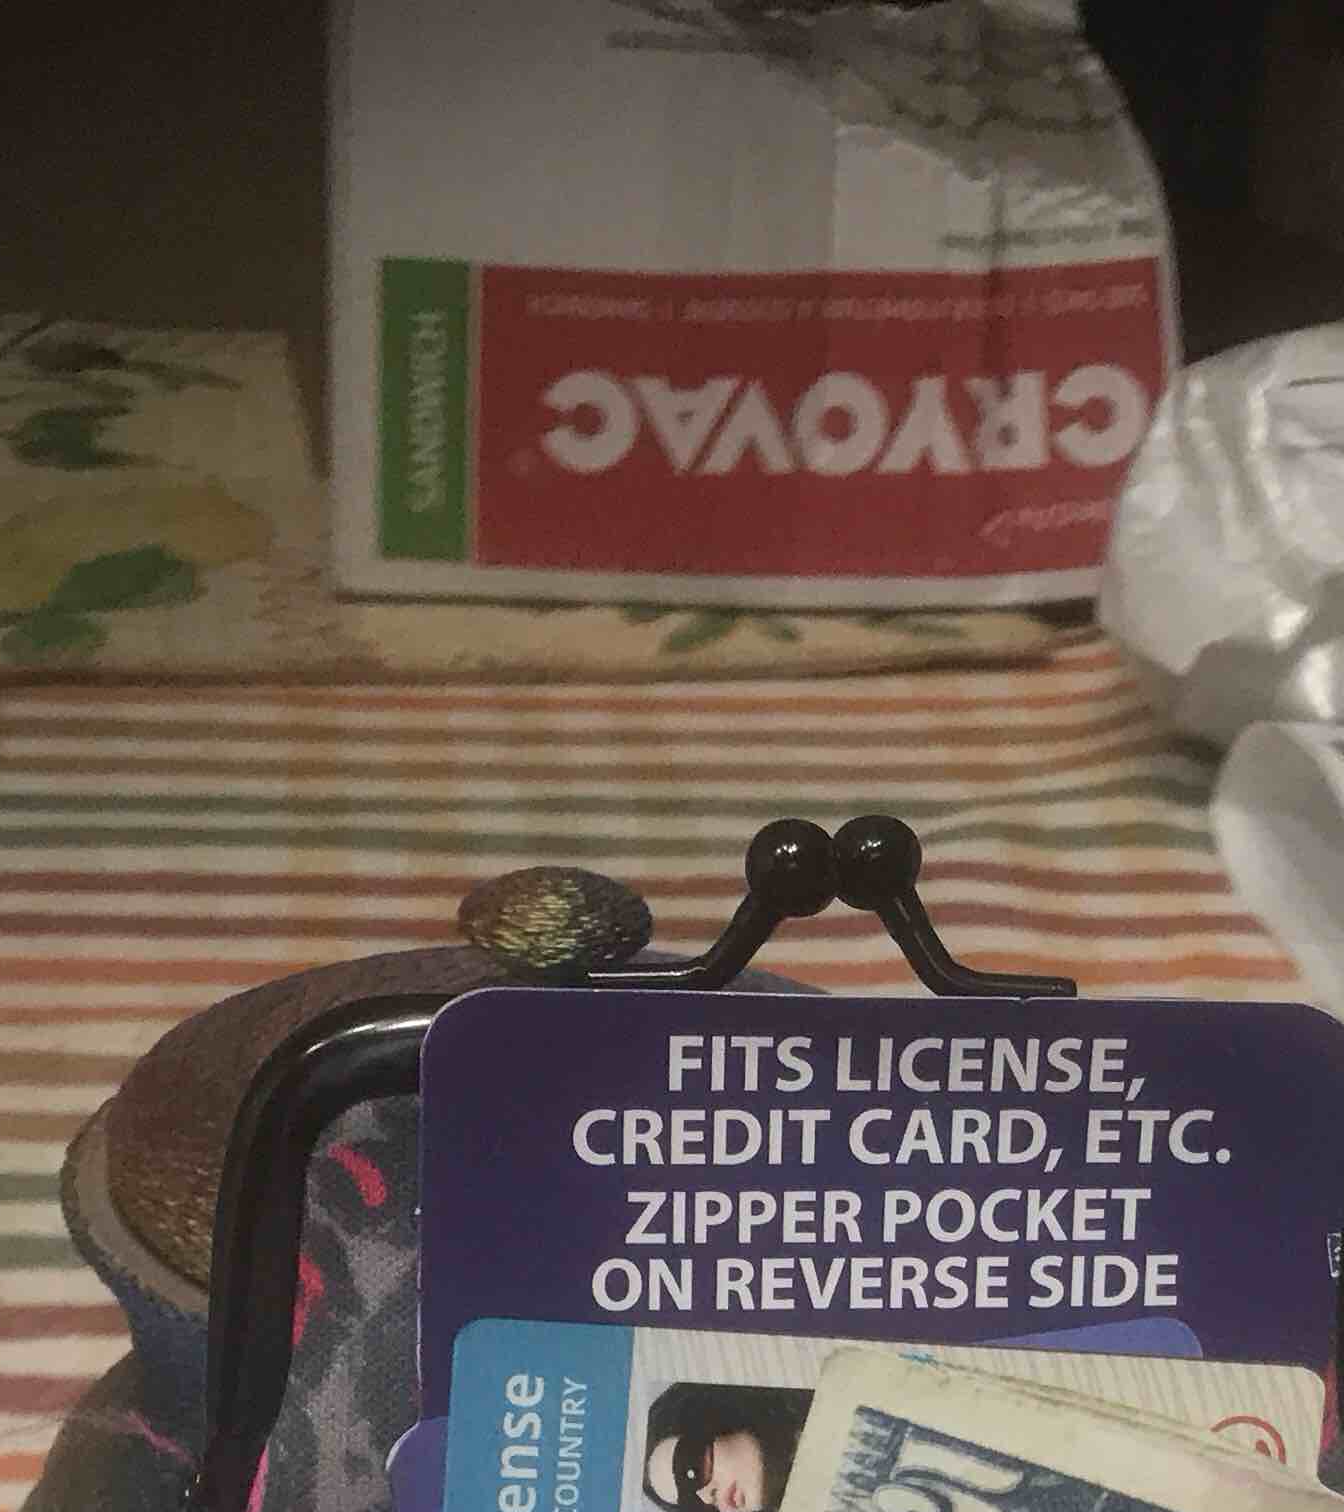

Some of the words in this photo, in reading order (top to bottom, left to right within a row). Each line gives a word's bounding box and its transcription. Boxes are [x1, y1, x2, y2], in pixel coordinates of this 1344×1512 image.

[540, 362, 1148, 478] CRYOVAC
[668, 1035, 814, 1093] FITS
[836, 1037, 1145, 1102] LICENSE,
[572, 1109, 831, 1166] CREDIT
[849, 1108, 1063, 1173] CARD,
[1085, 1109, 1231, 1164] ETC.
[625, 1190, 863, 1244] ZIPPER
[883, 1188, 1152, 1243] POCKET
[591, 1258, 693, 1313] ON
[716, 1255, 1009, 1311] REVERSE
[1028, 1254, 1179, 1308] SIDE
